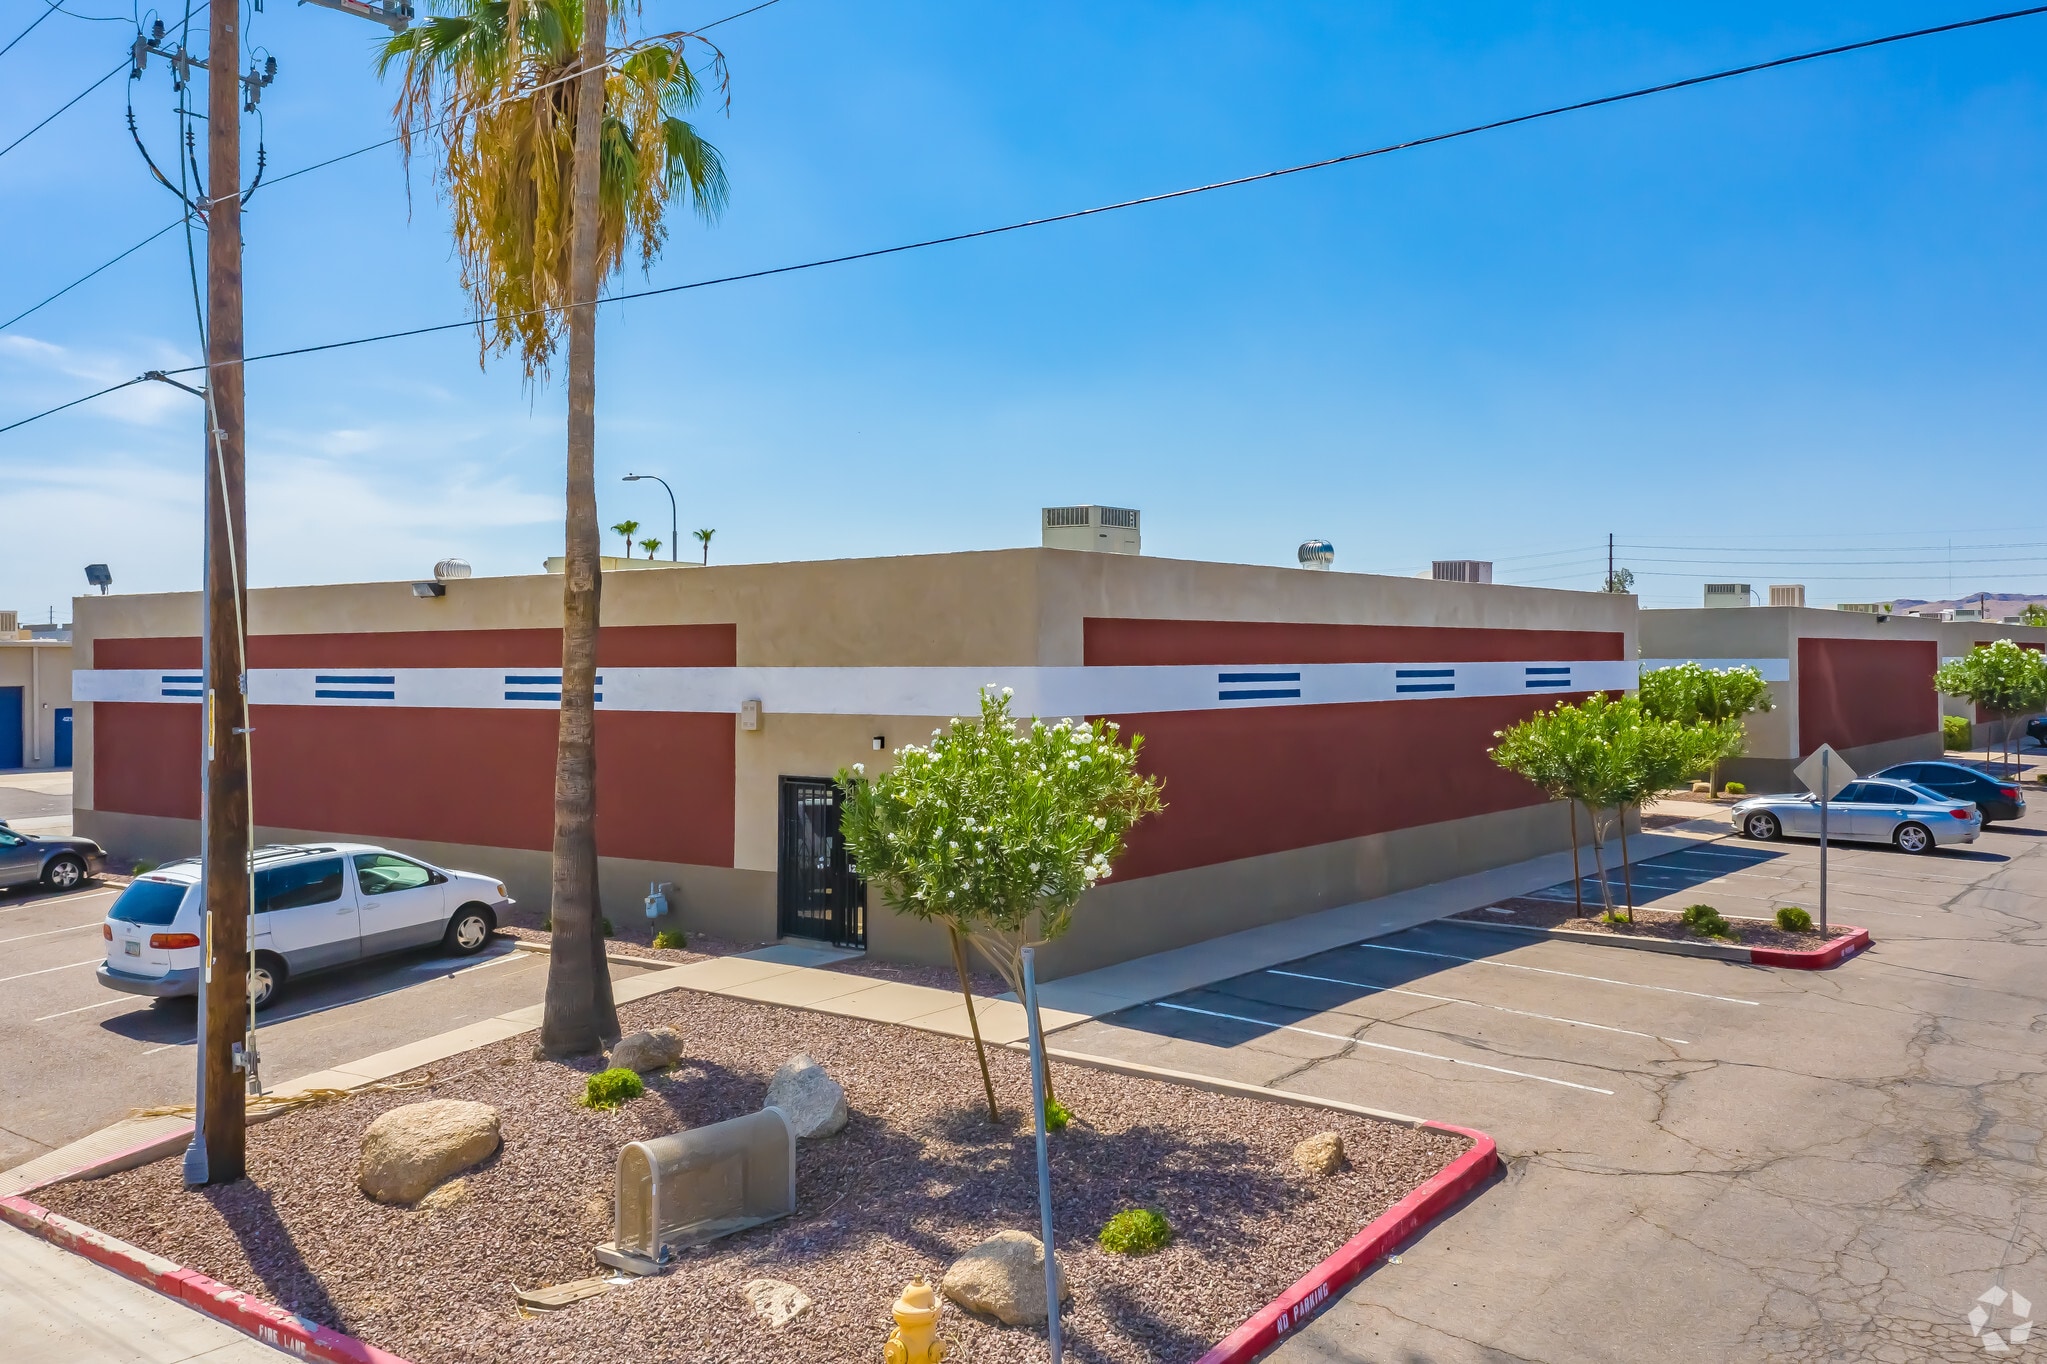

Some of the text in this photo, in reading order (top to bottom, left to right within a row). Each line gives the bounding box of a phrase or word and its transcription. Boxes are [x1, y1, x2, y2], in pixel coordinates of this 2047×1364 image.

[1277, 1282, 1329, 1334] NO PARKING
[258, 1324, 306, 1357] FIRE LANE
